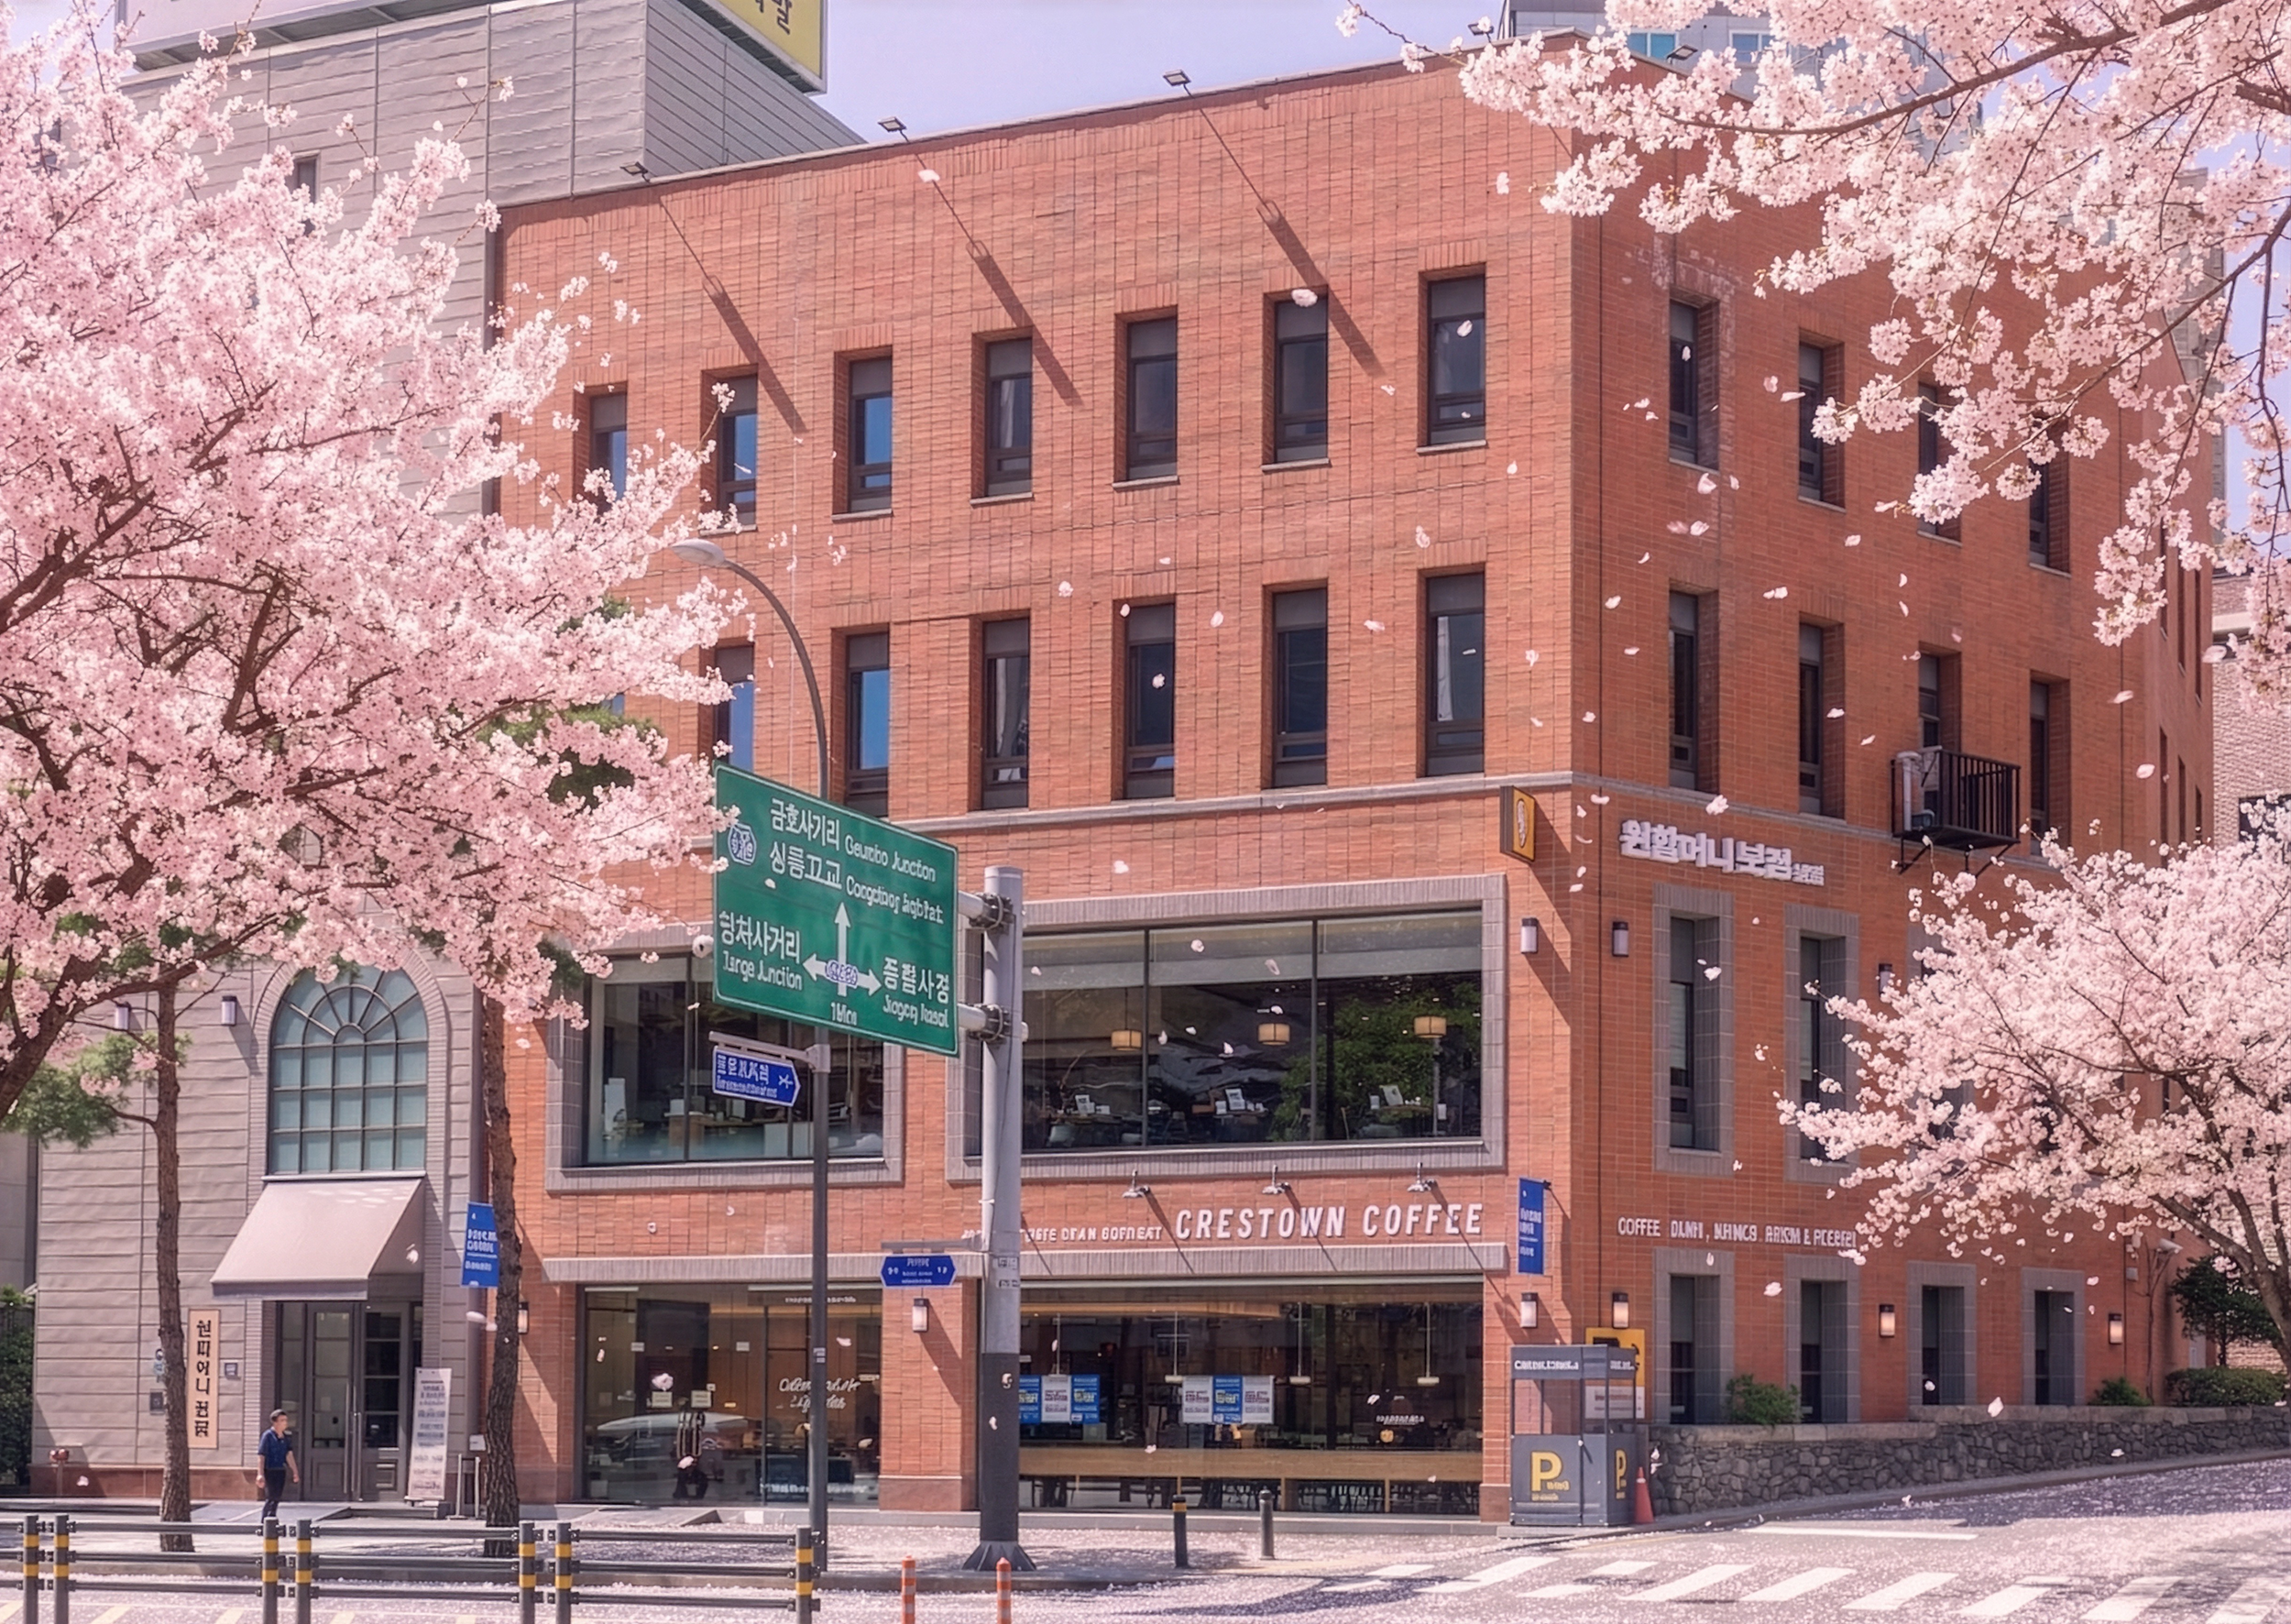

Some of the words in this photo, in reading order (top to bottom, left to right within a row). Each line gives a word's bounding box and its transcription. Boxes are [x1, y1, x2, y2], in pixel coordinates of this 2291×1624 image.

[1176, 1206, 1345, 1239] CRESTOWN
[1362, 1203, 1483, 1235] COFFEE
[1617, 1217, 1661, 1237] COFFEE
[1531, 1452, 1562, 1491] P
[1616, 1449, 1627, 1490] P
